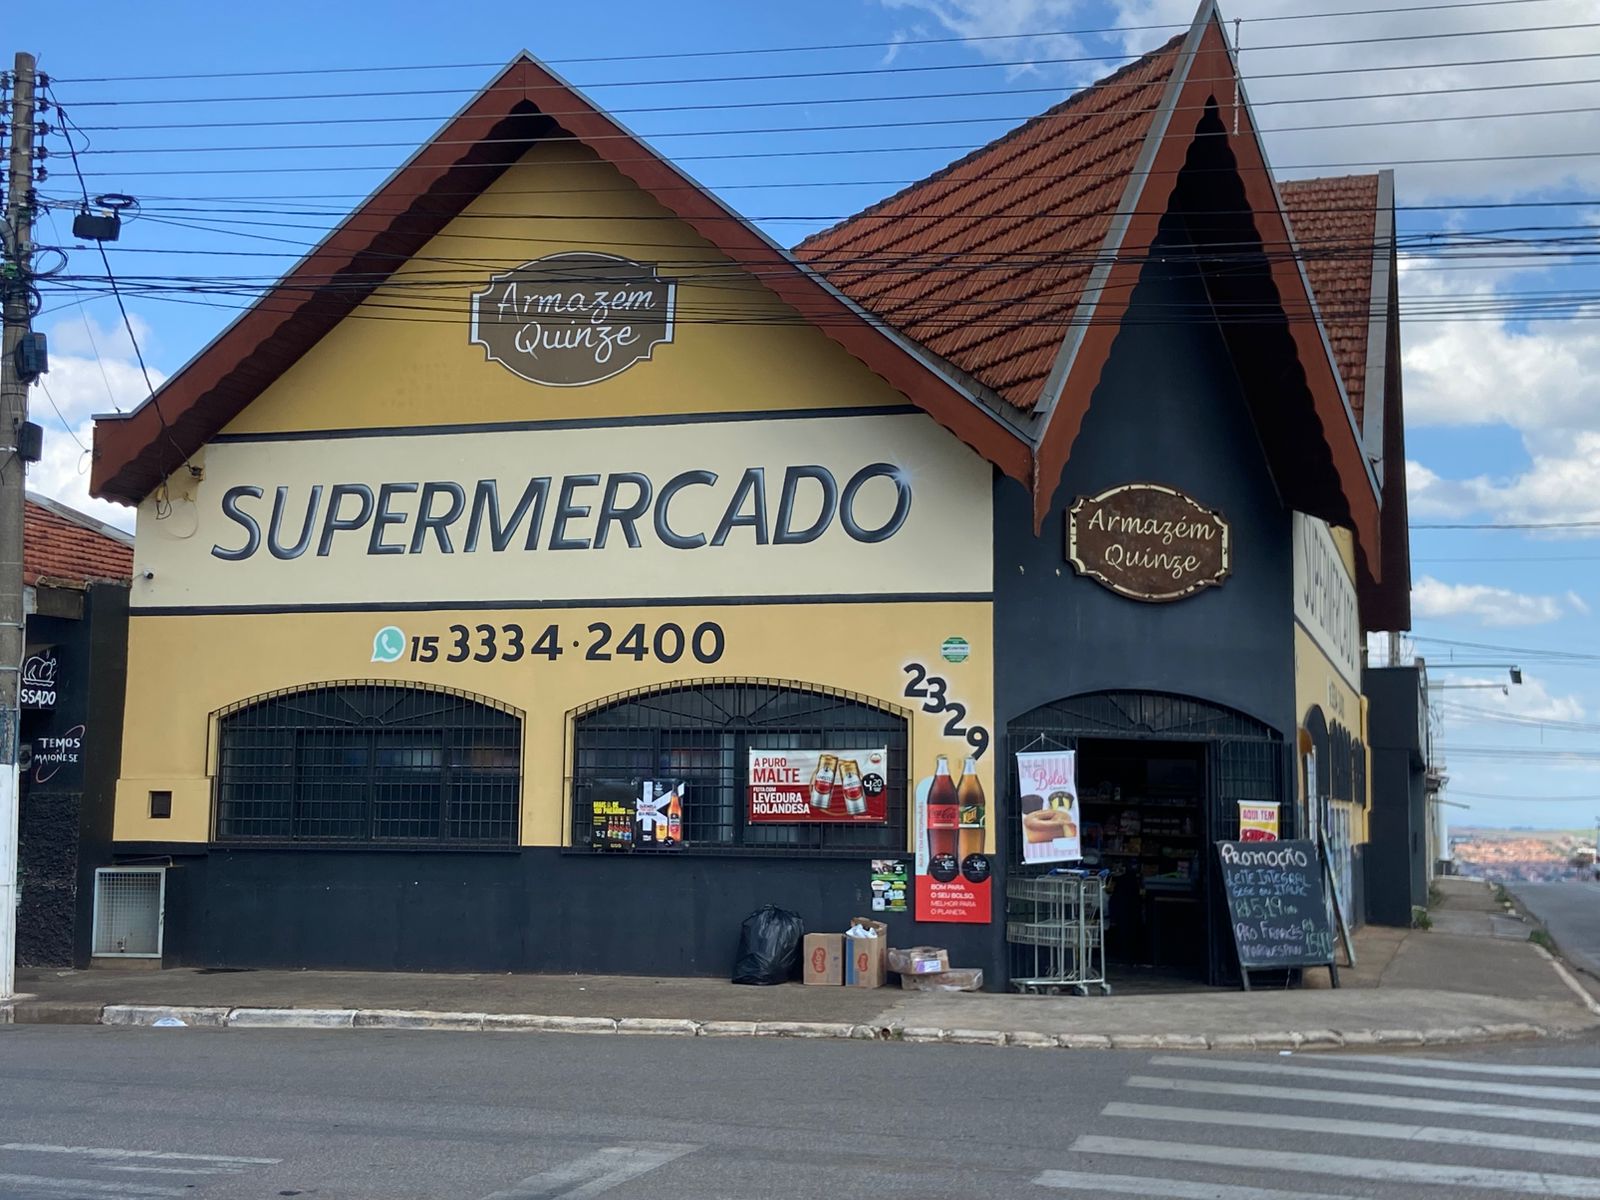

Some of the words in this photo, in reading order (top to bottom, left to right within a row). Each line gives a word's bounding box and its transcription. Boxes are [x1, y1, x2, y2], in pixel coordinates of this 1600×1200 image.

[498, 282, 656, 325] Armazém
[514, 320, 640, 364] Quinze
[211, 461, 913, 562] SUPERMERCADO
[1088, 508, 1216, 545] Armazém
[1105, 543, 1201, 580] Quinze
[410, 636, 439, 662] 15
[903, 662, 990, 761] 2329
[38, 737, 81, 753] TEMOS
[34, 753, 79, 765] MAIONESE
[754, 757, 761, 768] A
[762, 757, 787, 768] PURO
[753, 768, 800, 783] MALTE
[753, 792, 803, 803] LEVEDURA
[753, 803, 811, 814] HOLANDESA
[1261, 810, 1275, 821] TEM
